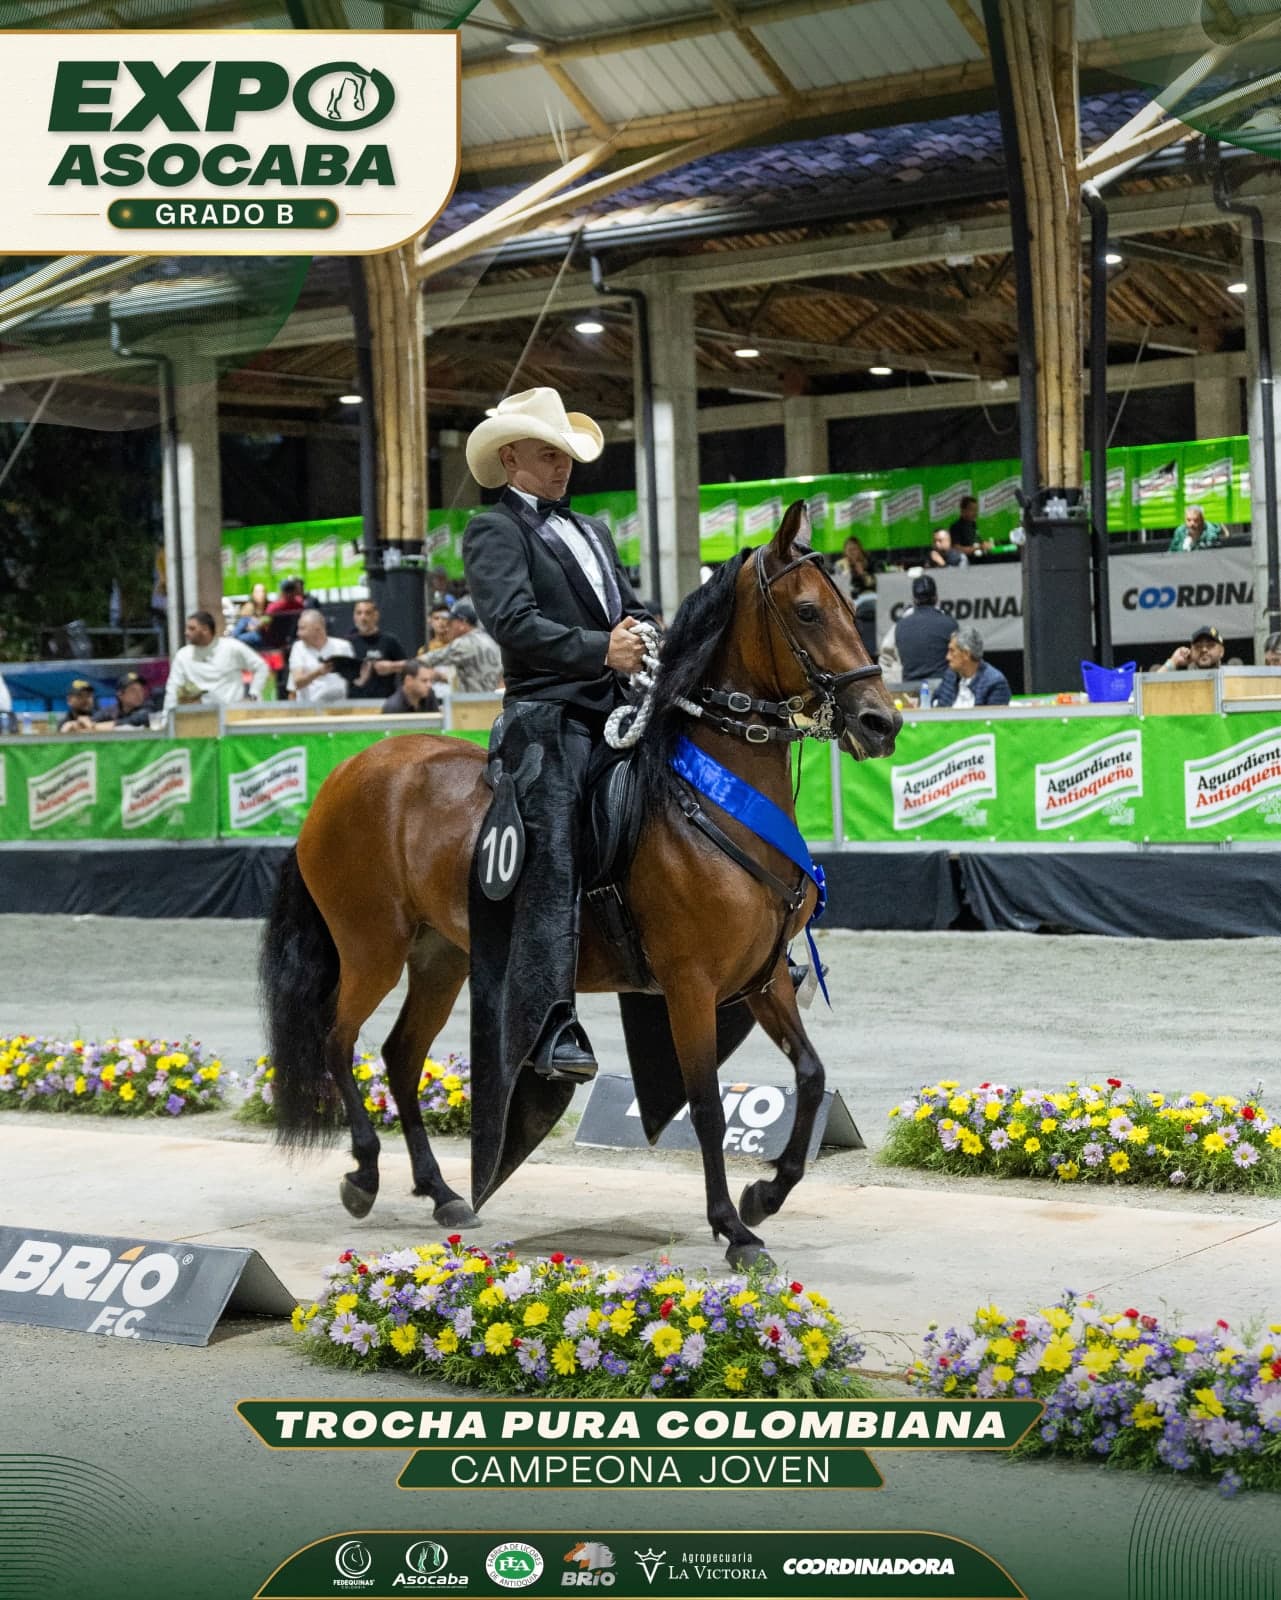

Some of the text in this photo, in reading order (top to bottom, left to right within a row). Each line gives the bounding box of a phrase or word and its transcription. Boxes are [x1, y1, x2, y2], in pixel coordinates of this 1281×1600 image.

[904, 754, 985, 795] Aguardiente
[904, 767, 987, 811] Antioqueño
[1045, 765, 1134, 811] Antioqueño
[1047, 751, 1133, 794] Aguardiente
[482, 825, 518, 884] 10
[87, 1306, 146, 1339] F.C.
